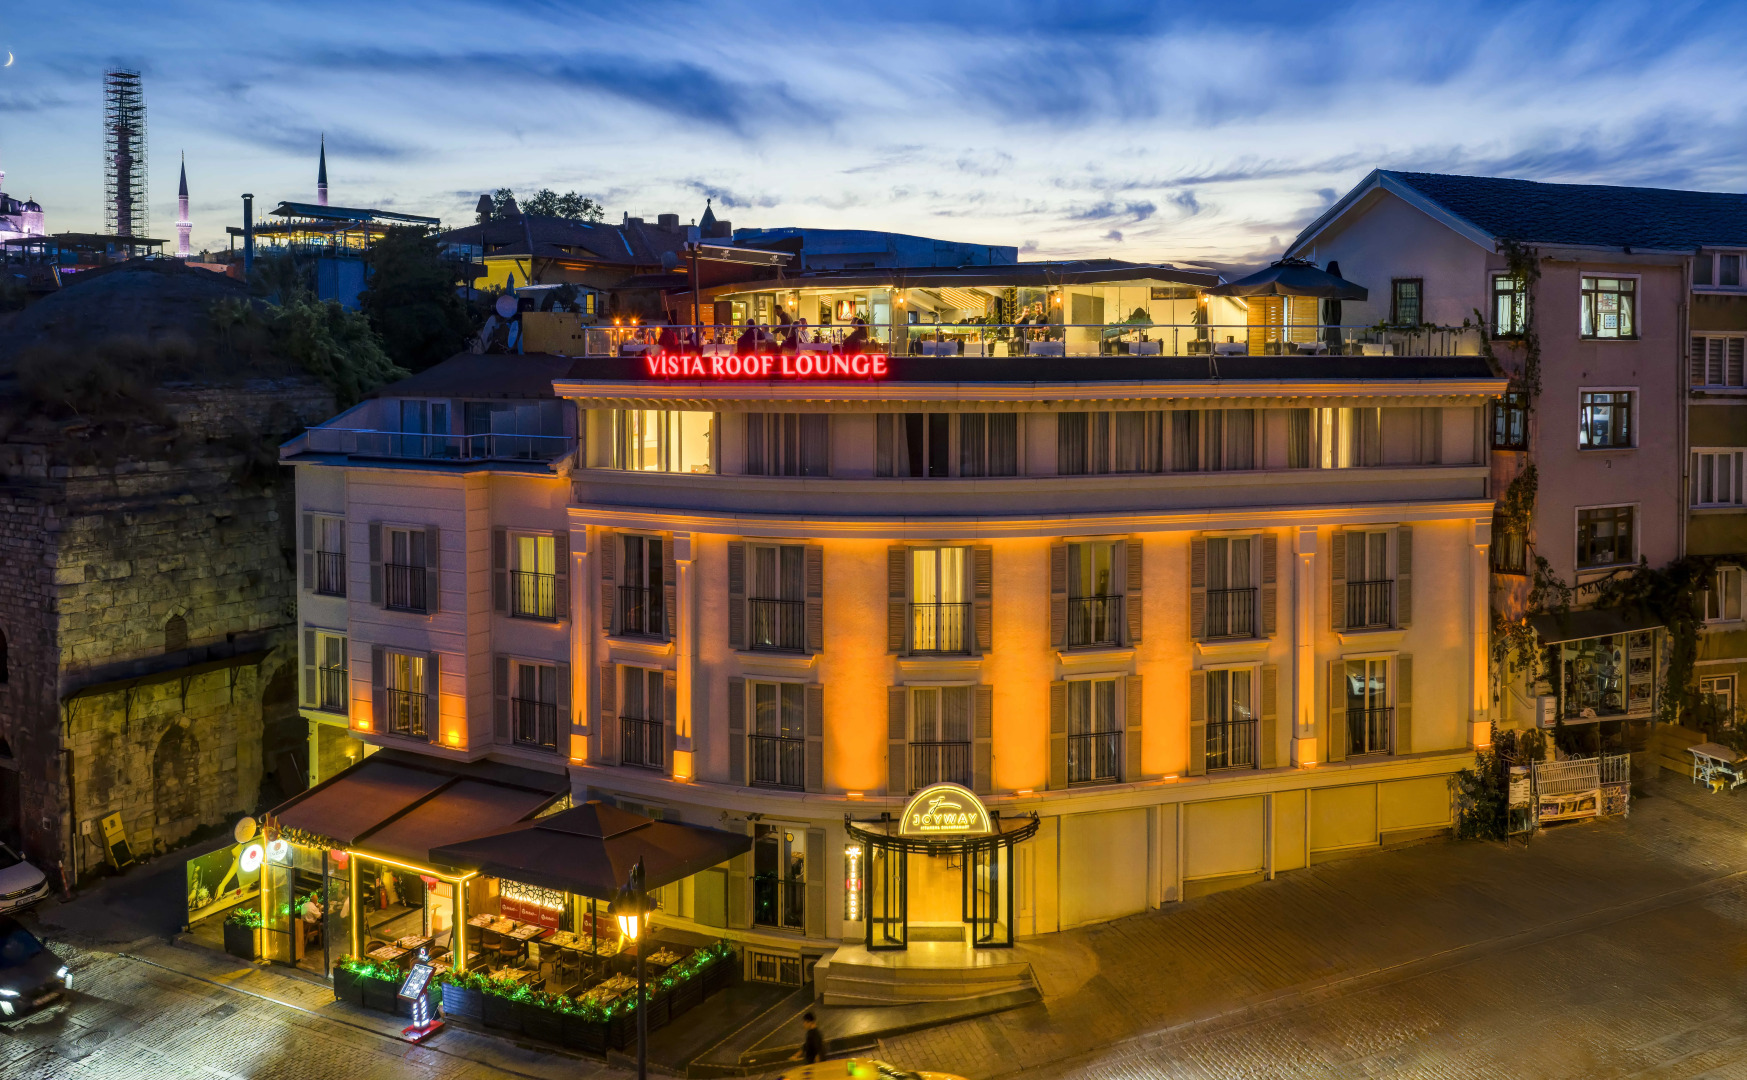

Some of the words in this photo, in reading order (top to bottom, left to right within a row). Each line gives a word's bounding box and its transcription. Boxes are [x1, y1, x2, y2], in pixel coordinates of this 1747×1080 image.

[711, 355, 774, 375] ROOF
[781, 354, 888, 375] LOUNGE
[912, 812, 978, 826] JOYWAY
